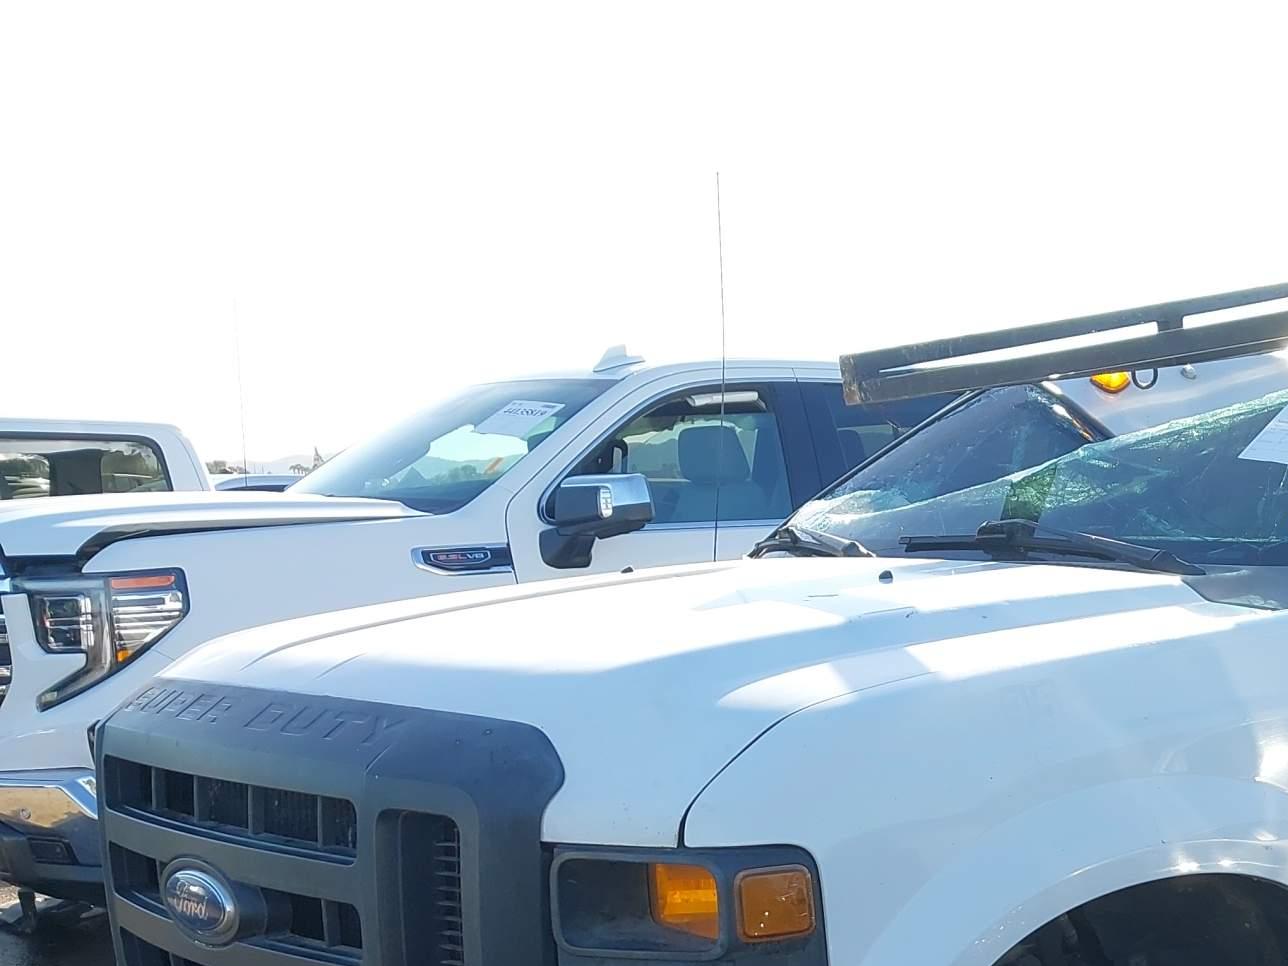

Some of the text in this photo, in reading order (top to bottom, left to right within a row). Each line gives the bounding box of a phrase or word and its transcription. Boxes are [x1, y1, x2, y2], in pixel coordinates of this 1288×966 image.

[124, 686, 406, 745] SUPER DUTY
[168, 879, 209, 921] Ford
